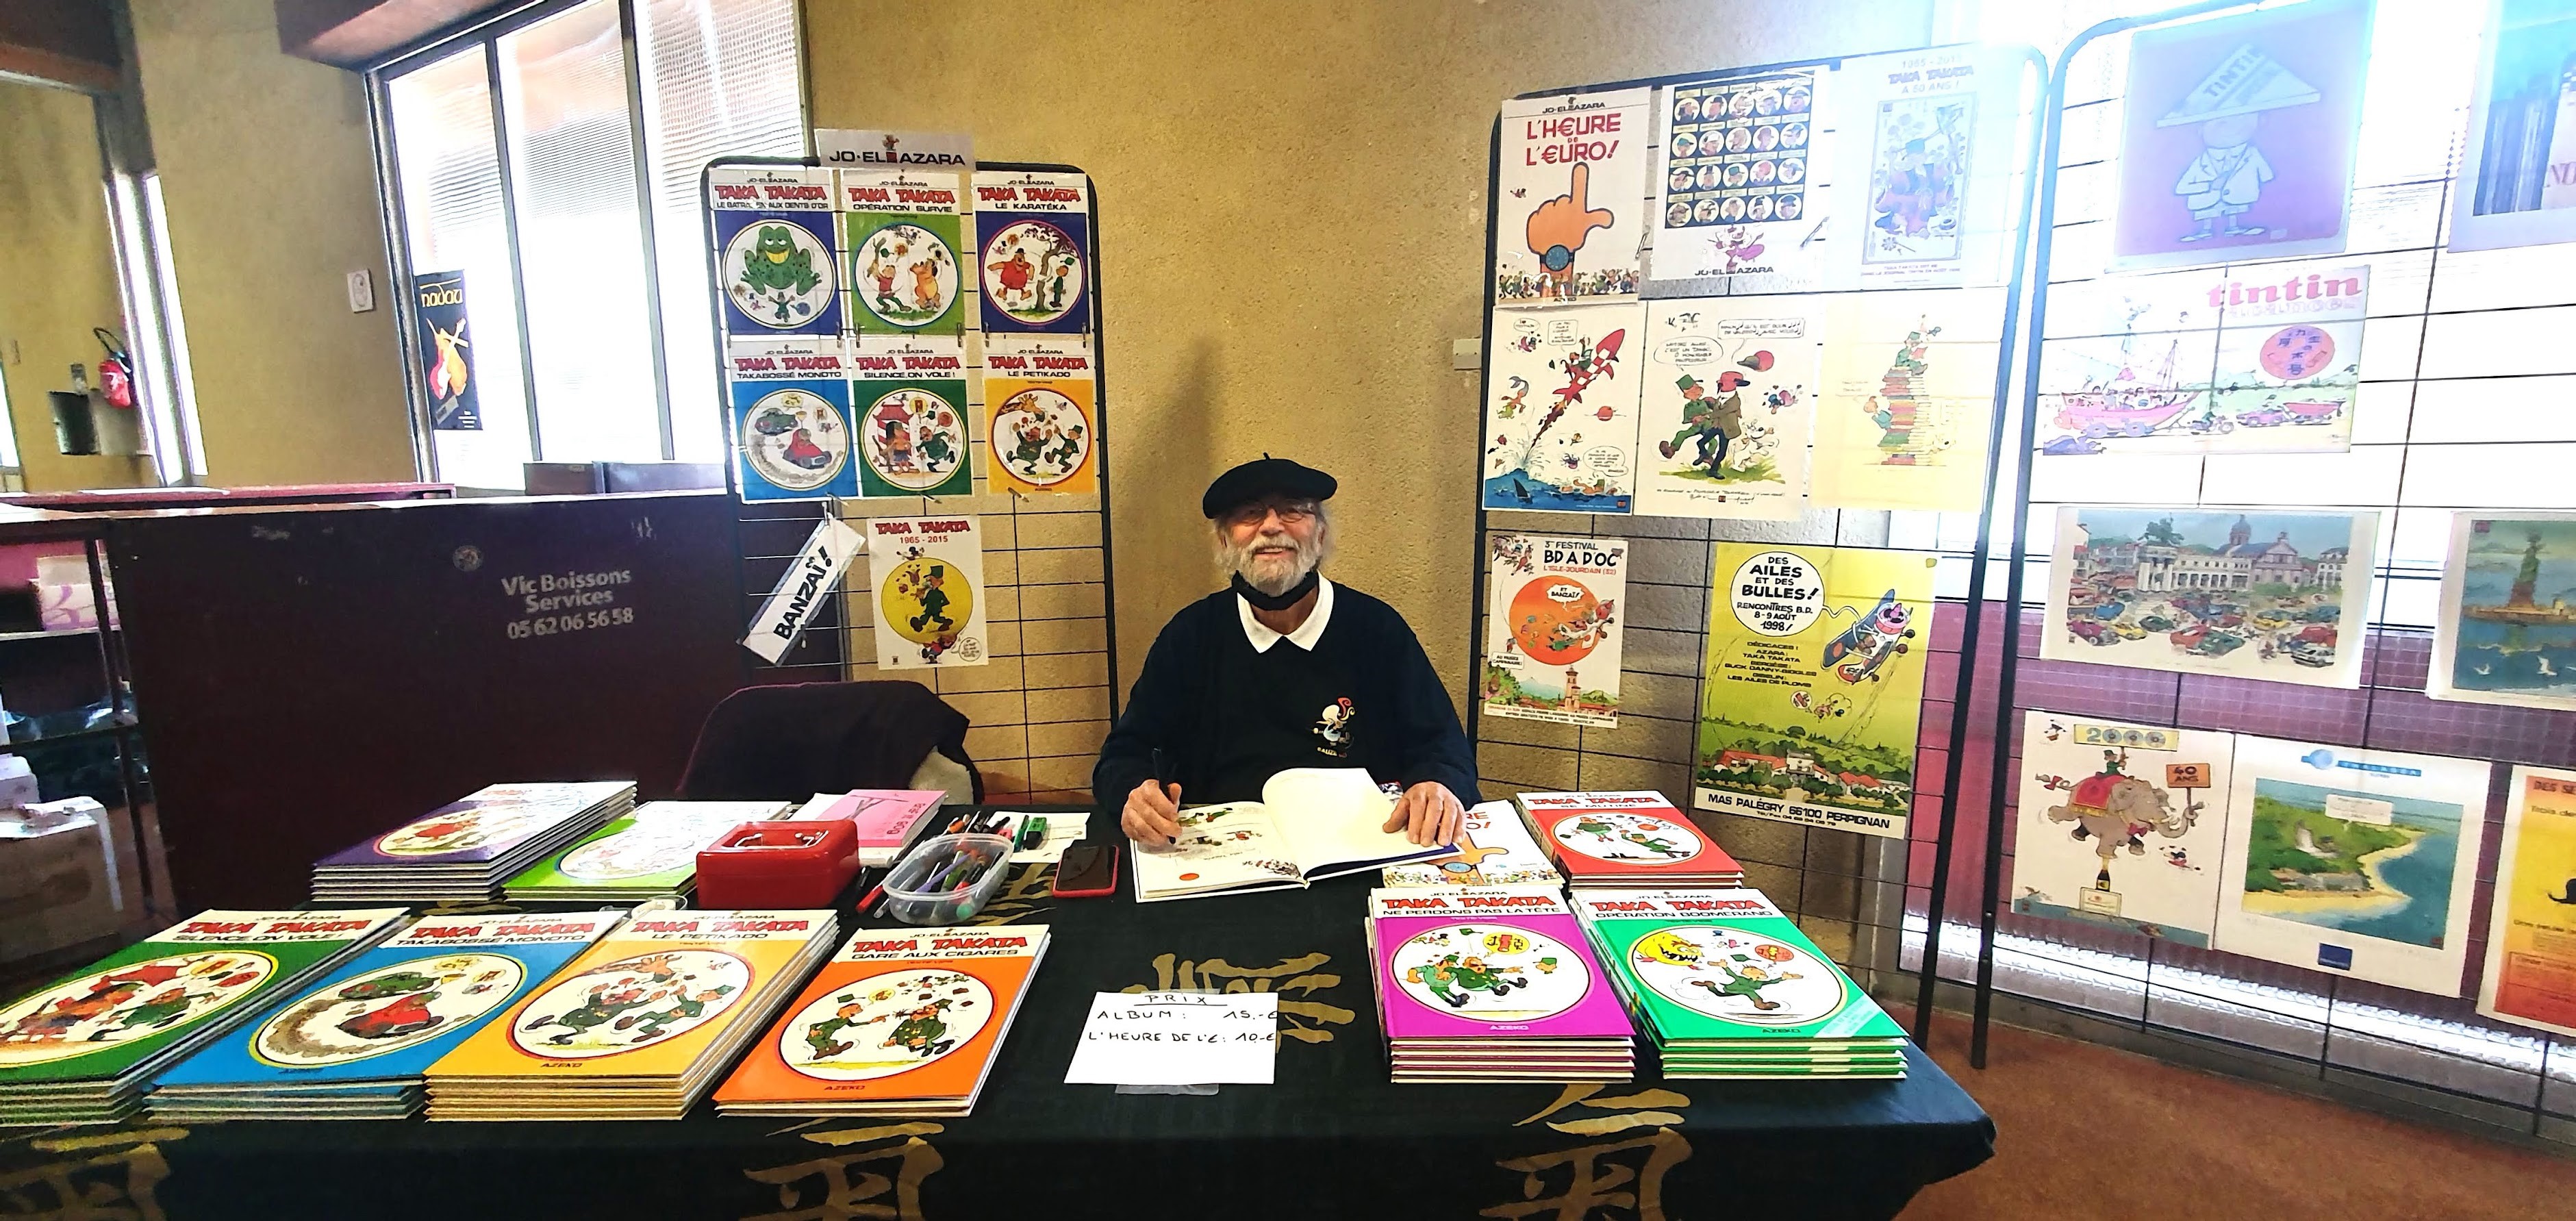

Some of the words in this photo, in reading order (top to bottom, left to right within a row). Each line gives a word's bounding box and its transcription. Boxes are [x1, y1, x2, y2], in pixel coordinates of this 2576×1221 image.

[899, 153, 965, 166] AZARA
[715, 186, 759, 200] TAKA
[764, 186, 827, 201] TAKATA
[848, 188, 890, 203] TAKA
[896, 189, 956, 204] TAKATA
[977, 187, 1018, 201] TAKA
[1023, 188, 1081, 202] TAKATA
[1737, 266, 1774, 275] AZARA
[2206, 274, 2362, 307] tintin
[735, 357, 776, 371] TAKA
[782, 357, 841, 370] TAKATA
[856, 357, 898, 370] TAKA
[902, 356, 961, 370] TAKATA
[989, 356, 1028, 369] TAKA
[1033, 356, 1088, 370] TAKATA
[875, 522, 911, 535] TAKA
[918, 520, 971, 533] TAKATA
[1556, 542, 1599, 550] FESTIVAL
[1544, 550, 1563, 564] BD
[1566, 551, 1578, 565] A
[1768, 557, 1789, 565] DES
[1750, 565, 1803, 578] AILES
[501, 576, 538, 596] Vic
[540, 568, 632, 594] Boissons
[1775, 578, 1794, 586] DES
[525, 588, 614, 614] Services
[1737, 601, 1793, 614] RENCONTRES
[507, 620, 531, 640] 05
[533, 617, 559, 637] 62
[560, 613, 585, 632] 06
[587, 612, 610, 629] 56
[611, 607, 635, 625] 58
[1767, 655, 1801, 663] TAKATA
[1707, 794, 1732, 805] MAS
[1736, 798, 1785, 813] PALÉGRY
[1789, 805, 1823, 819] 66100
[1826, 811, 1891, 829] PERPIGNAN
[1381, 898, 1450, 909] TAKA
[1457, 896, 1556, 908] TAKATA
[1589, 901, 1656, 911] TAKA
[1666, 899, 1766, 910] TAKATA
[1526, 906, 1561, 914] TÊTE
[1595, 909, 1680, 918] OPÉRATION
[178, 922, 258, 934] TAKA
[263, 920, 372, 933] TAKATA
[409, 926, 483, 939] TAKA
[493, 923, 596, 936] TAKATA
[630, 921, 699, 933] TAKA
[711, 920, 809, 933] TAKATA
[853, 940, 918, 953] TAKA
[932, 937, 1028, 951] TAKATA
[944, 949, 1019, 957] CIGARES
[1097, 1010, 1172, 1020] ALBUM
[1172, 1033, 1191, 1042] DE
